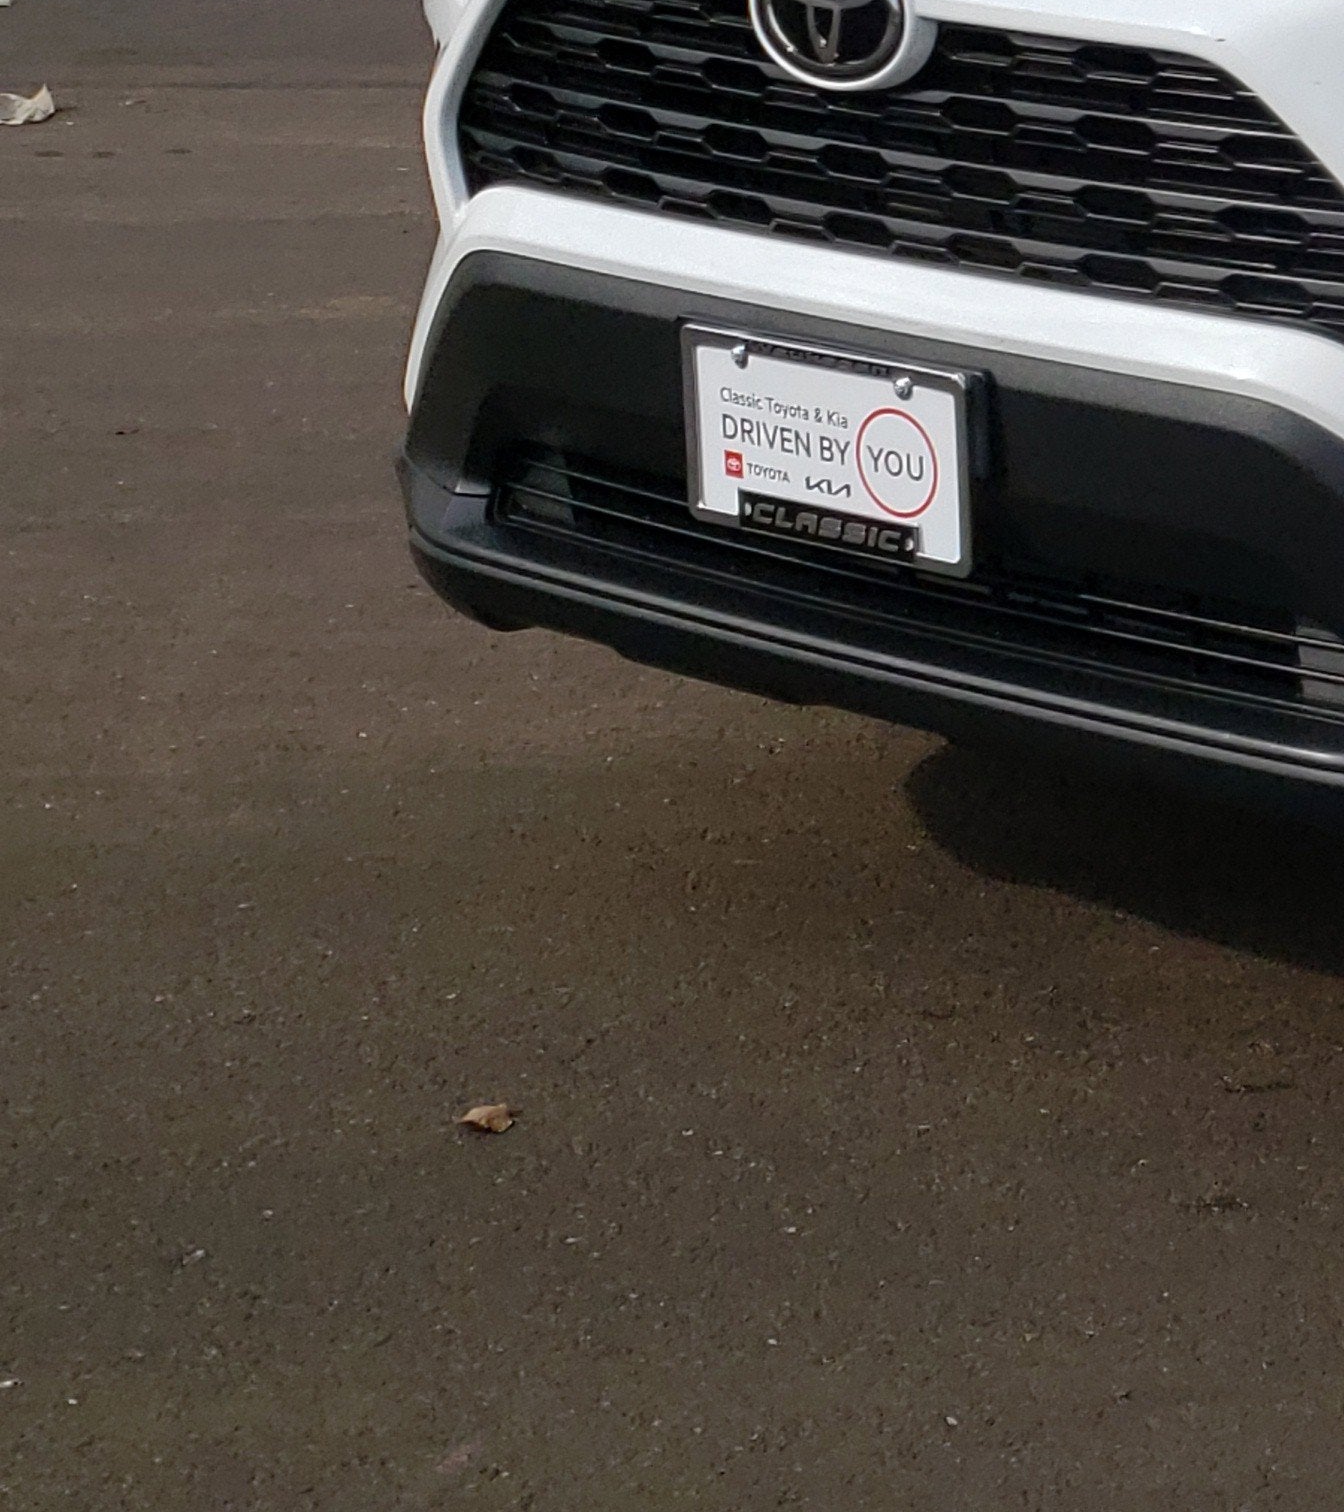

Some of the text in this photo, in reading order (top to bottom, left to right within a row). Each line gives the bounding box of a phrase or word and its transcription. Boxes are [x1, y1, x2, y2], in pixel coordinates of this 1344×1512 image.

[719, 386, 848, 429] Classic Toyota & Kia
[722, 413, 924, 481] DRIVEN BY YOU
[746, 462, 791, 483] TOYOTA
[752, 502, 902, 553] CLASSIC
